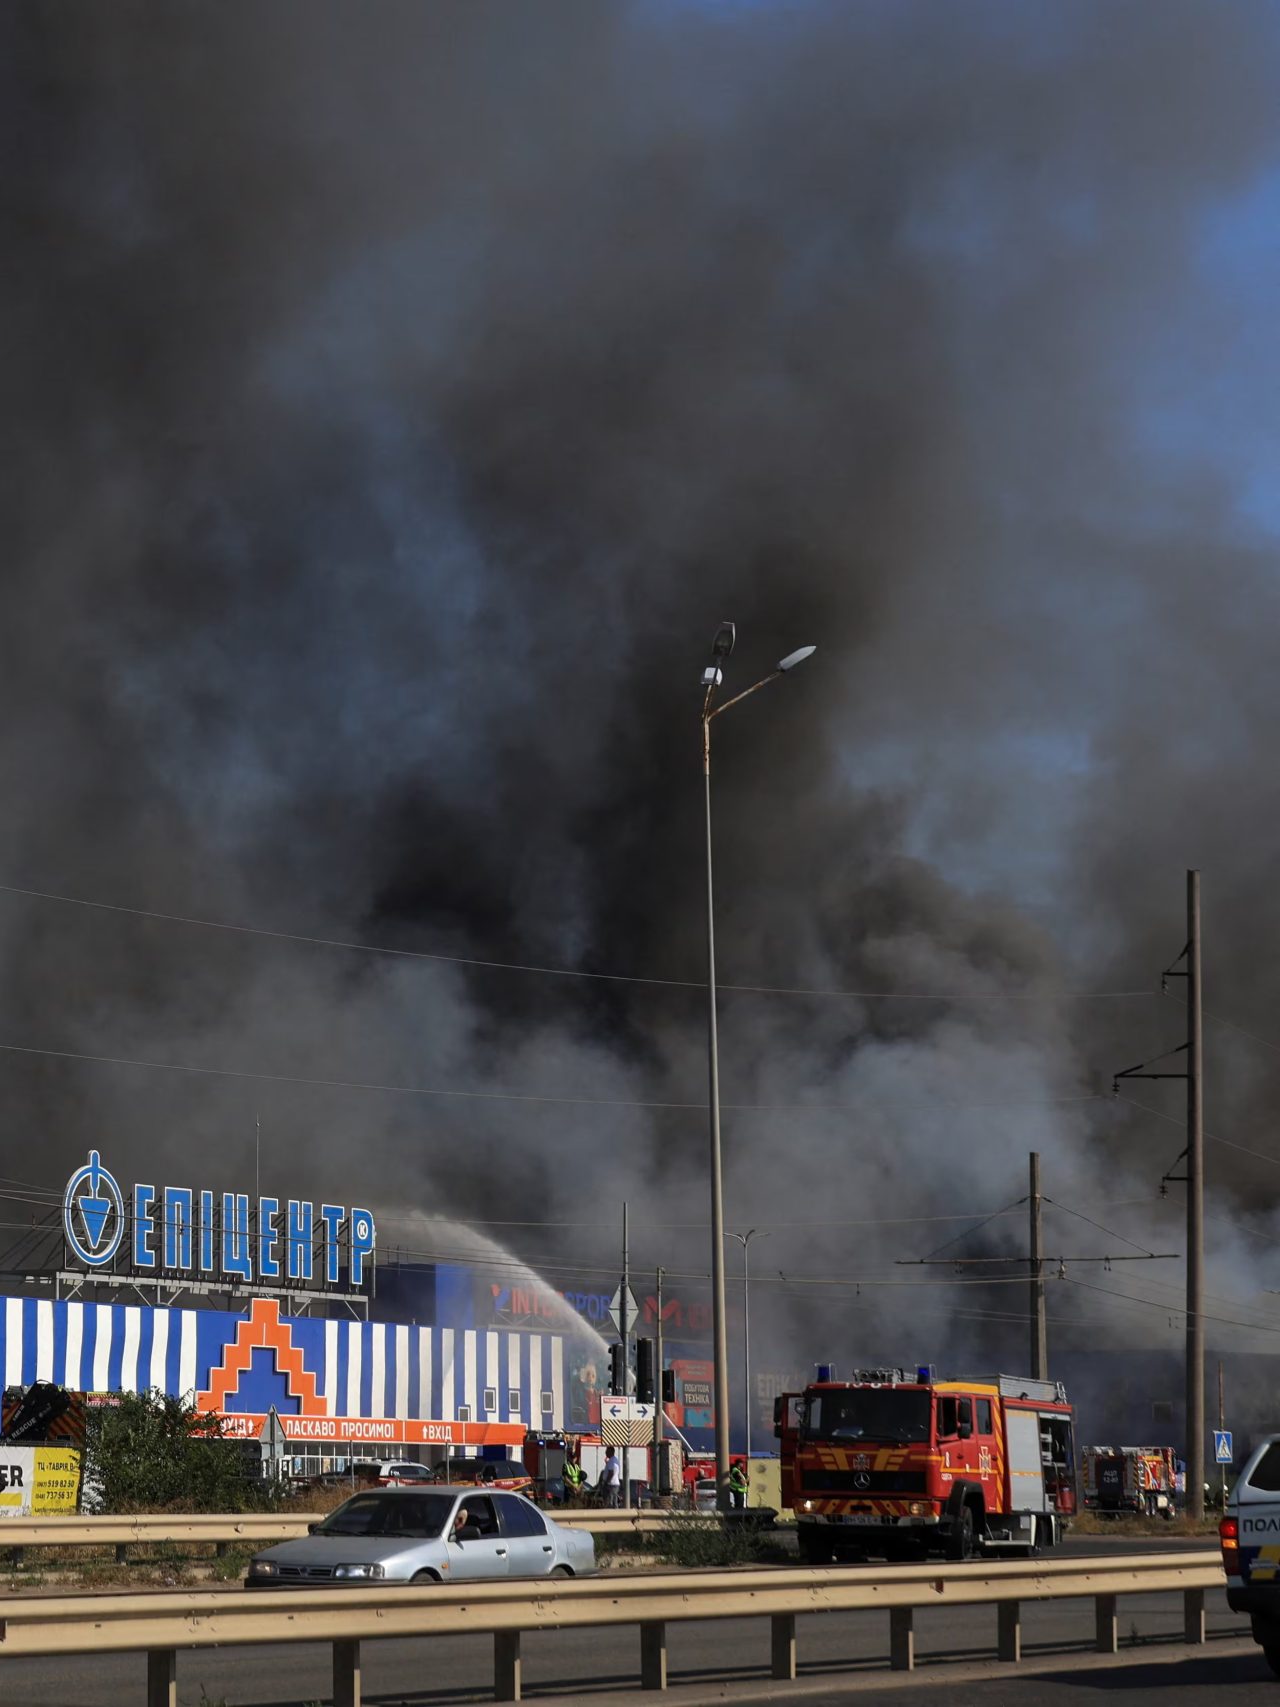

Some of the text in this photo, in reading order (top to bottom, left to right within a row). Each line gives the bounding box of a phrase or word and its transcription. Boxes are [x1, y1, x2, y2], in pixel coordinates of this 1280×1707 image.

[134, 1183, 376, 1286] ЕПІЦЕНТР
[285, 1420, 336, 1436] ЛАСКАВО
[428, 1425, 453, 1442] ВХІД
[1243, 1518, 1280, 1532] ПОЛ
